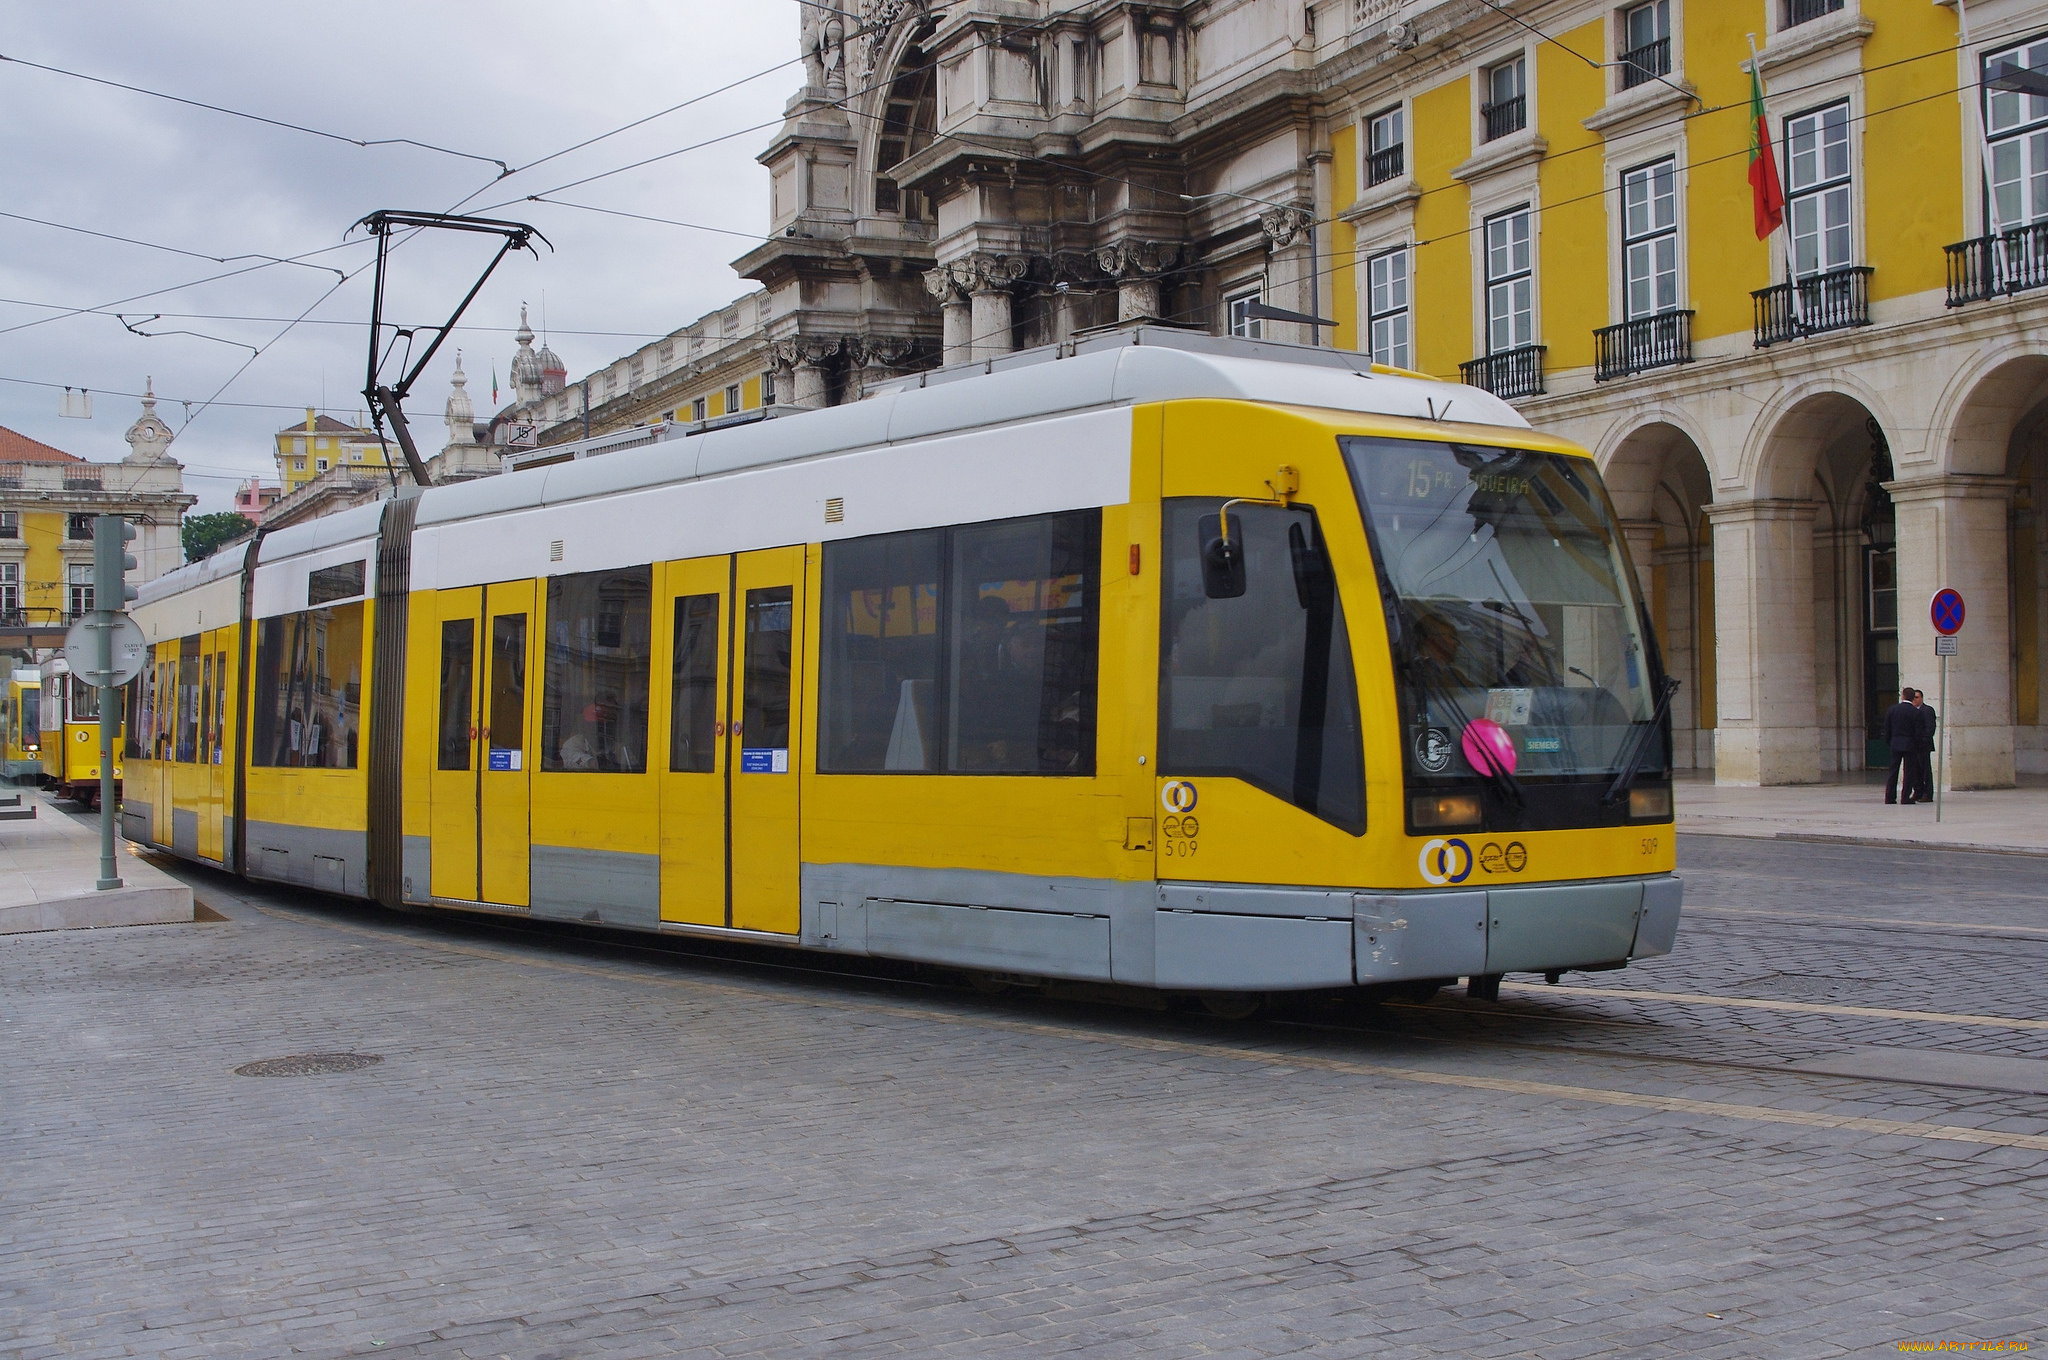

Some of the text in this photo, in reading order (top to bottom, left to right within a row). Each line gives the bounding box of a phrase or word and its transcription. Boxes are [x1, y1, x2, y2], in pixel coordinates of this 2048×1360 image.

[516, 426, 529, 439] 15
[1408, 460, 1433, 498] 15
[1527, 741, 1559, 750] SIEMENS
[1165, 840, 1198, 858] 509
[1641, 837, 1658, 855] 509
